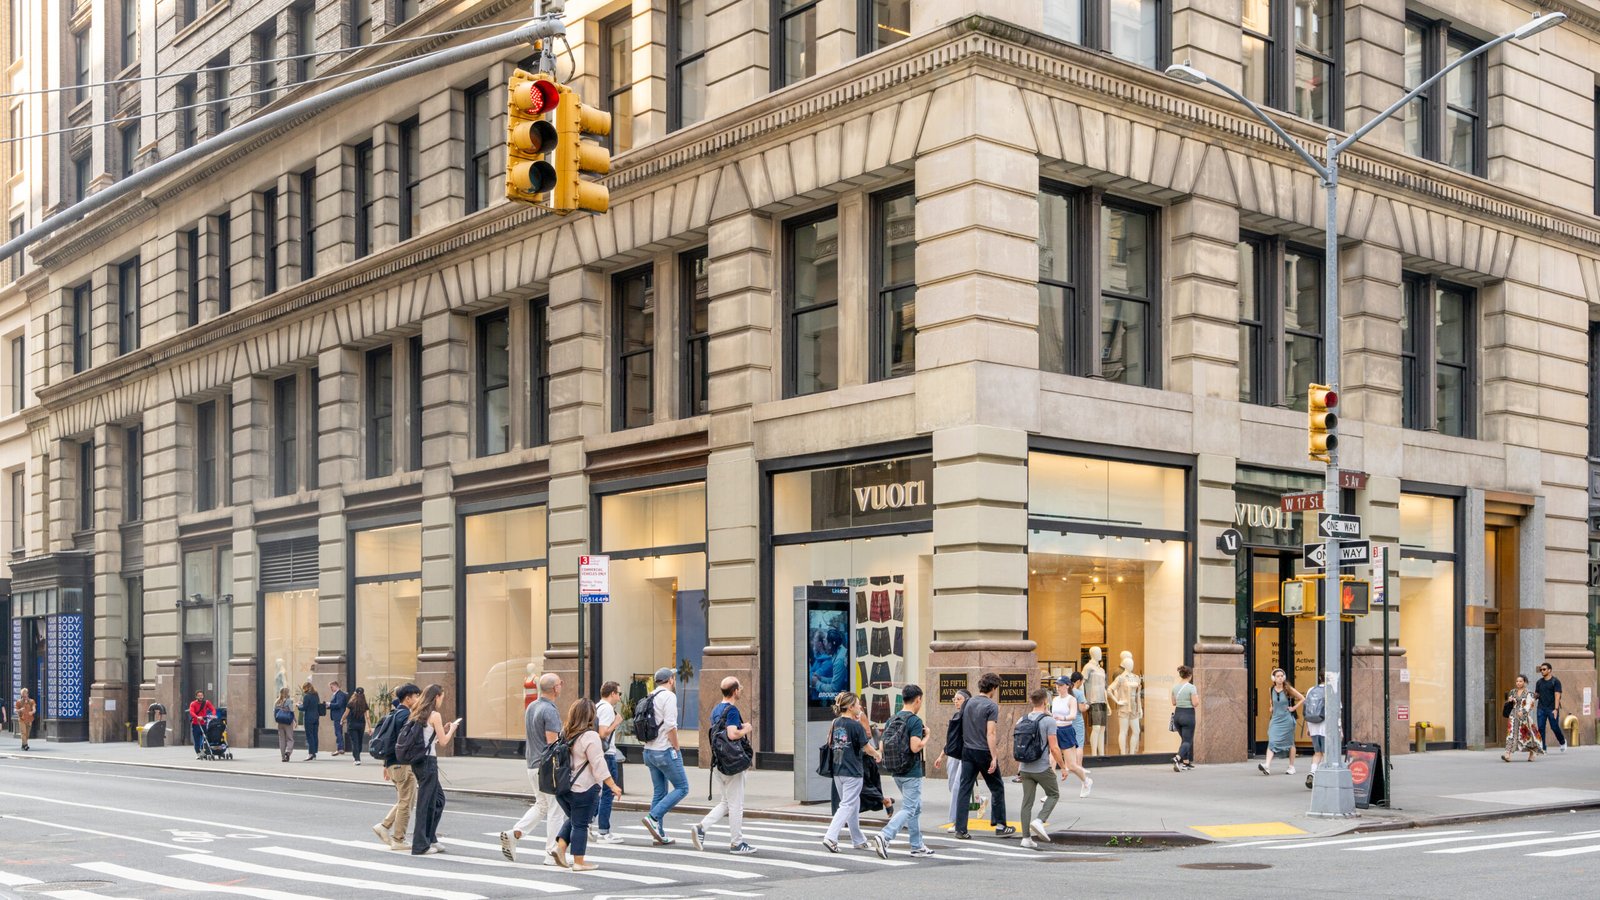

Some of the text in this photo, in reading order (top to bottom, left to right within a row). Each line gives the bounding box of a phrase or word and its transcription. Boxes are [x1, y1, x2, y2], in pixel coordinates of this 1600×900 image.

[1345, 475, 1359, 487] 5 Av
[853, 480, 927, 512] vuori
[1285, 496, 1319, 510] W 17 St
[1326, 522, 1357, 532] ONE WAY
[1316, 548, 1363, 560] ON WAY
[582, 556, 588, 565] 3
